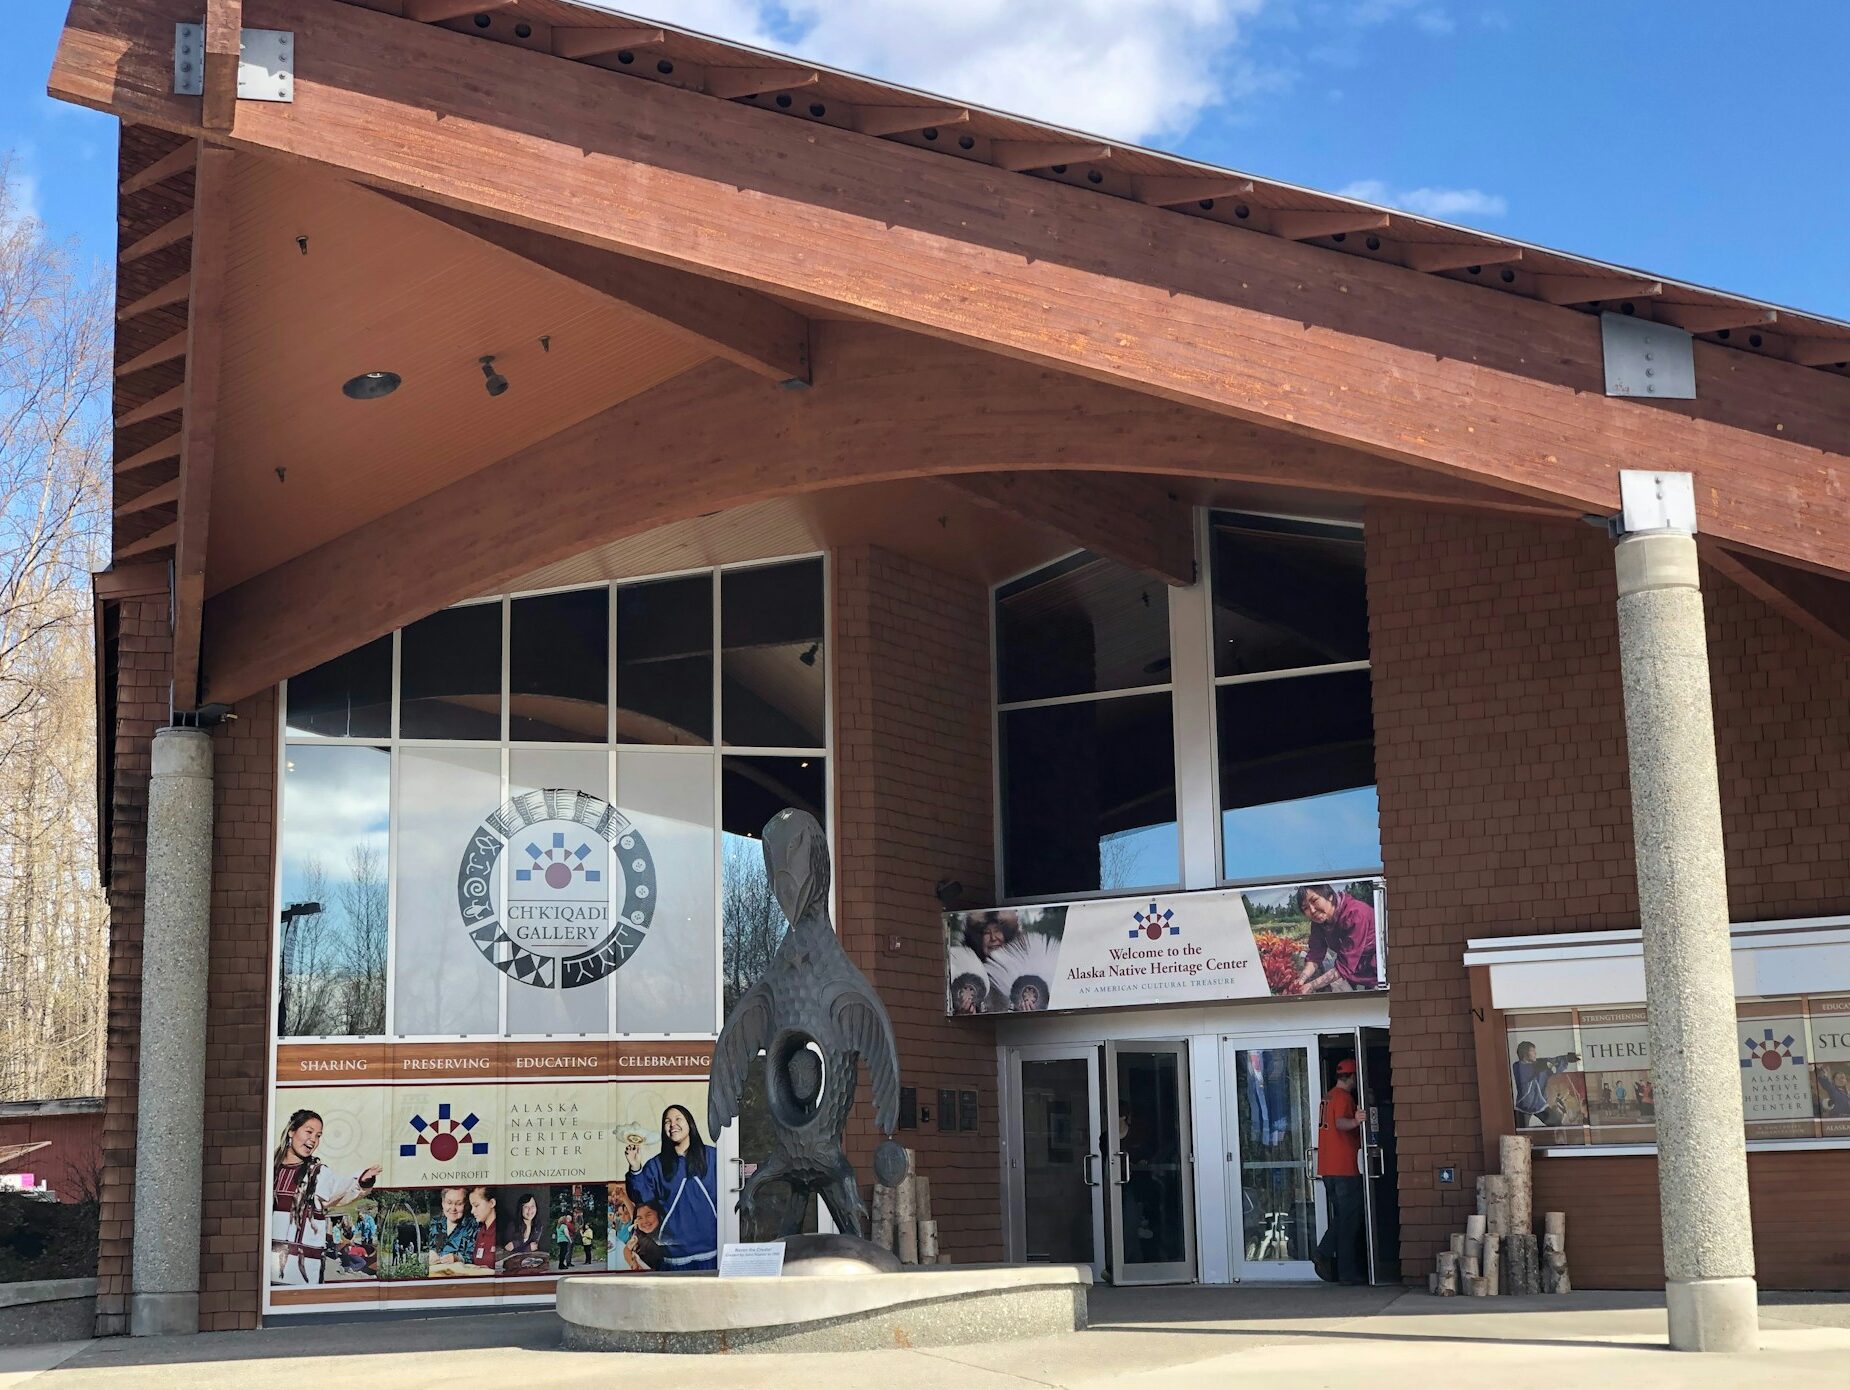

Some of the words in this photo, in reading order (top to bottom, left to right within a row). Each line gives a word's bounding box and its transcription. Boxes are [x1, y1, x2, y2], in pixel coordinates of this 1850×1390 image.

[517, 926, 599, 940] GALLERY
[1109, 947, 1162, 961] Welcome
[1167, 946, 1179, 957] to
[1183, 943, 1202, 955] the
[1067, 966, 1105, 980] Alaska
[1109, 963, 1147, 977] Native
[1150, 961, 1203, 977] Heritage
[1206, 958, 1249, 971] Center
[1093, 984, 1138, 993] AMERICAN
[1141, 981, 1186, 990] CULTURAL
[1191, 978, 1236, 987] TREASURE
[1582, 1012, 1646, 1022] STRENGTHENING
[1586, 1042, 1647, 1058] THERE
[300, 1059, 368, 1072] SHARING
[403, 1057, 490, 1070] PRESERVING
[516, 1056, 598, 1068] EDUCATING
[619, 1055, 711, 1067] CELEBRATING
[1751, 1074, 1798, 1083] ALASKA
[1752, 1083, 1798, 1093] NATIVE
[1745, 1092, 1808, 1102] HERITAGE
[510, 1103, 579, 1113] ALASKA
[1752, 1102, 1802, 1112] CENTER
[511, 1117, 579, 1127] NATIVE
[511, 1131, 604, 1142] HERITAGE
[510, 1145, 583, 1157] CENTER
[421, 1172, 428, 1181] A
[431, 1170, 490, 1180] NONPROFIT
[510, 1168, 586, 1178] ORGANIZATION
